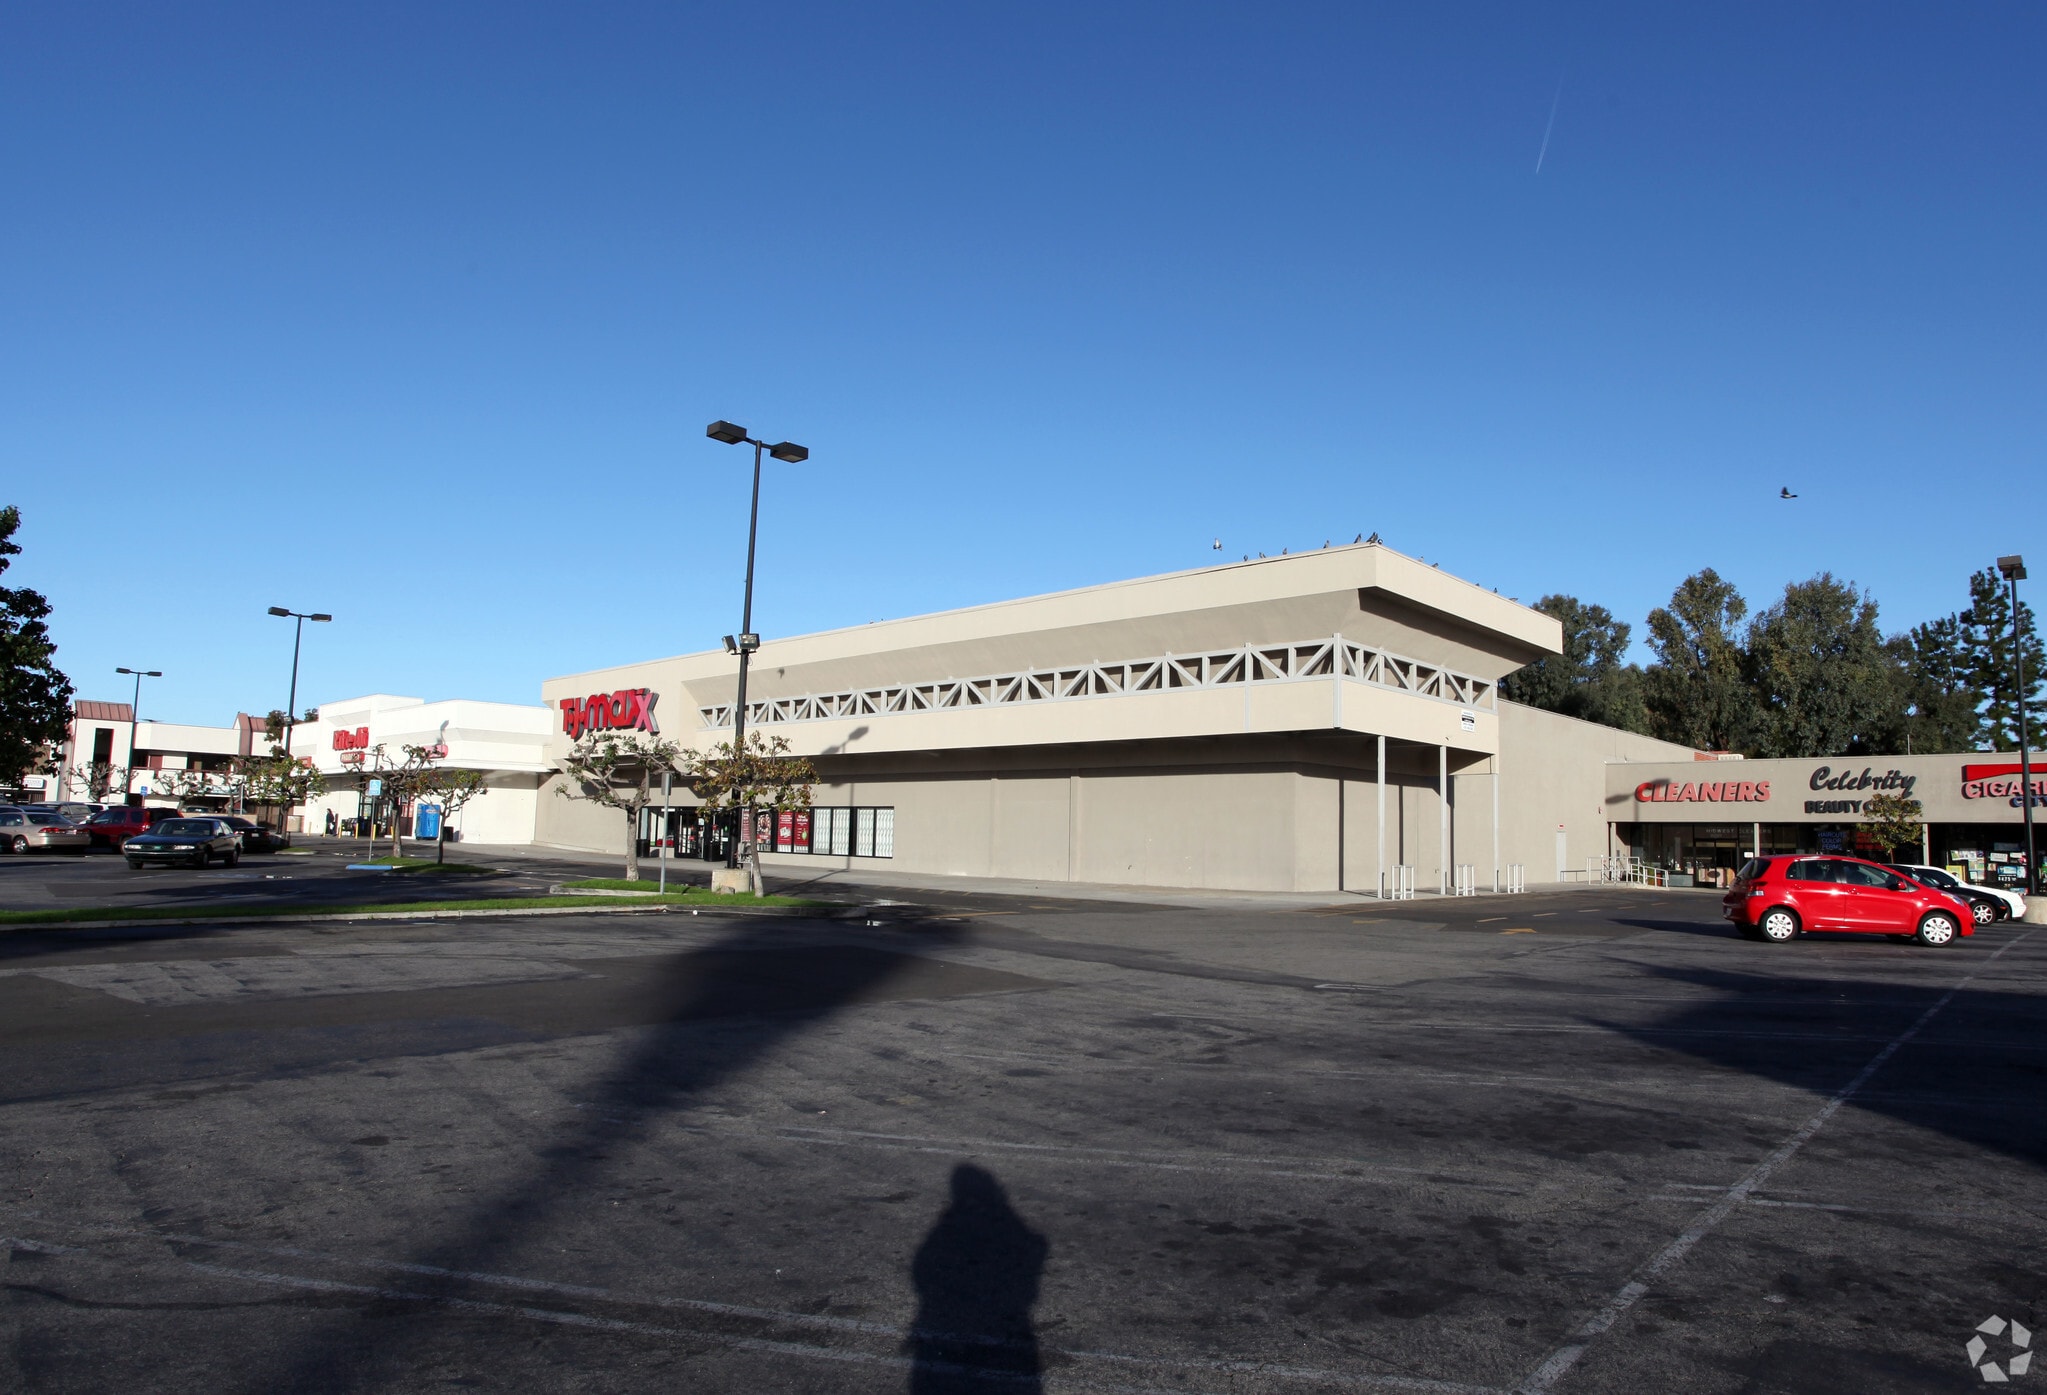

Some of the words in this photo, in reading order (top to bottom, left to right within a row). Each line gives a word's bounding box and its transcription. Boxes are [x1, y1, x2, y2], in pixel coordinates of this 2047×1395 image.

[1635, 781, 1770, 802] CLEANERS
[1809, 766, 1916, 799] Celebrity
[1804, 800, 1862, 813] BEAUTY
